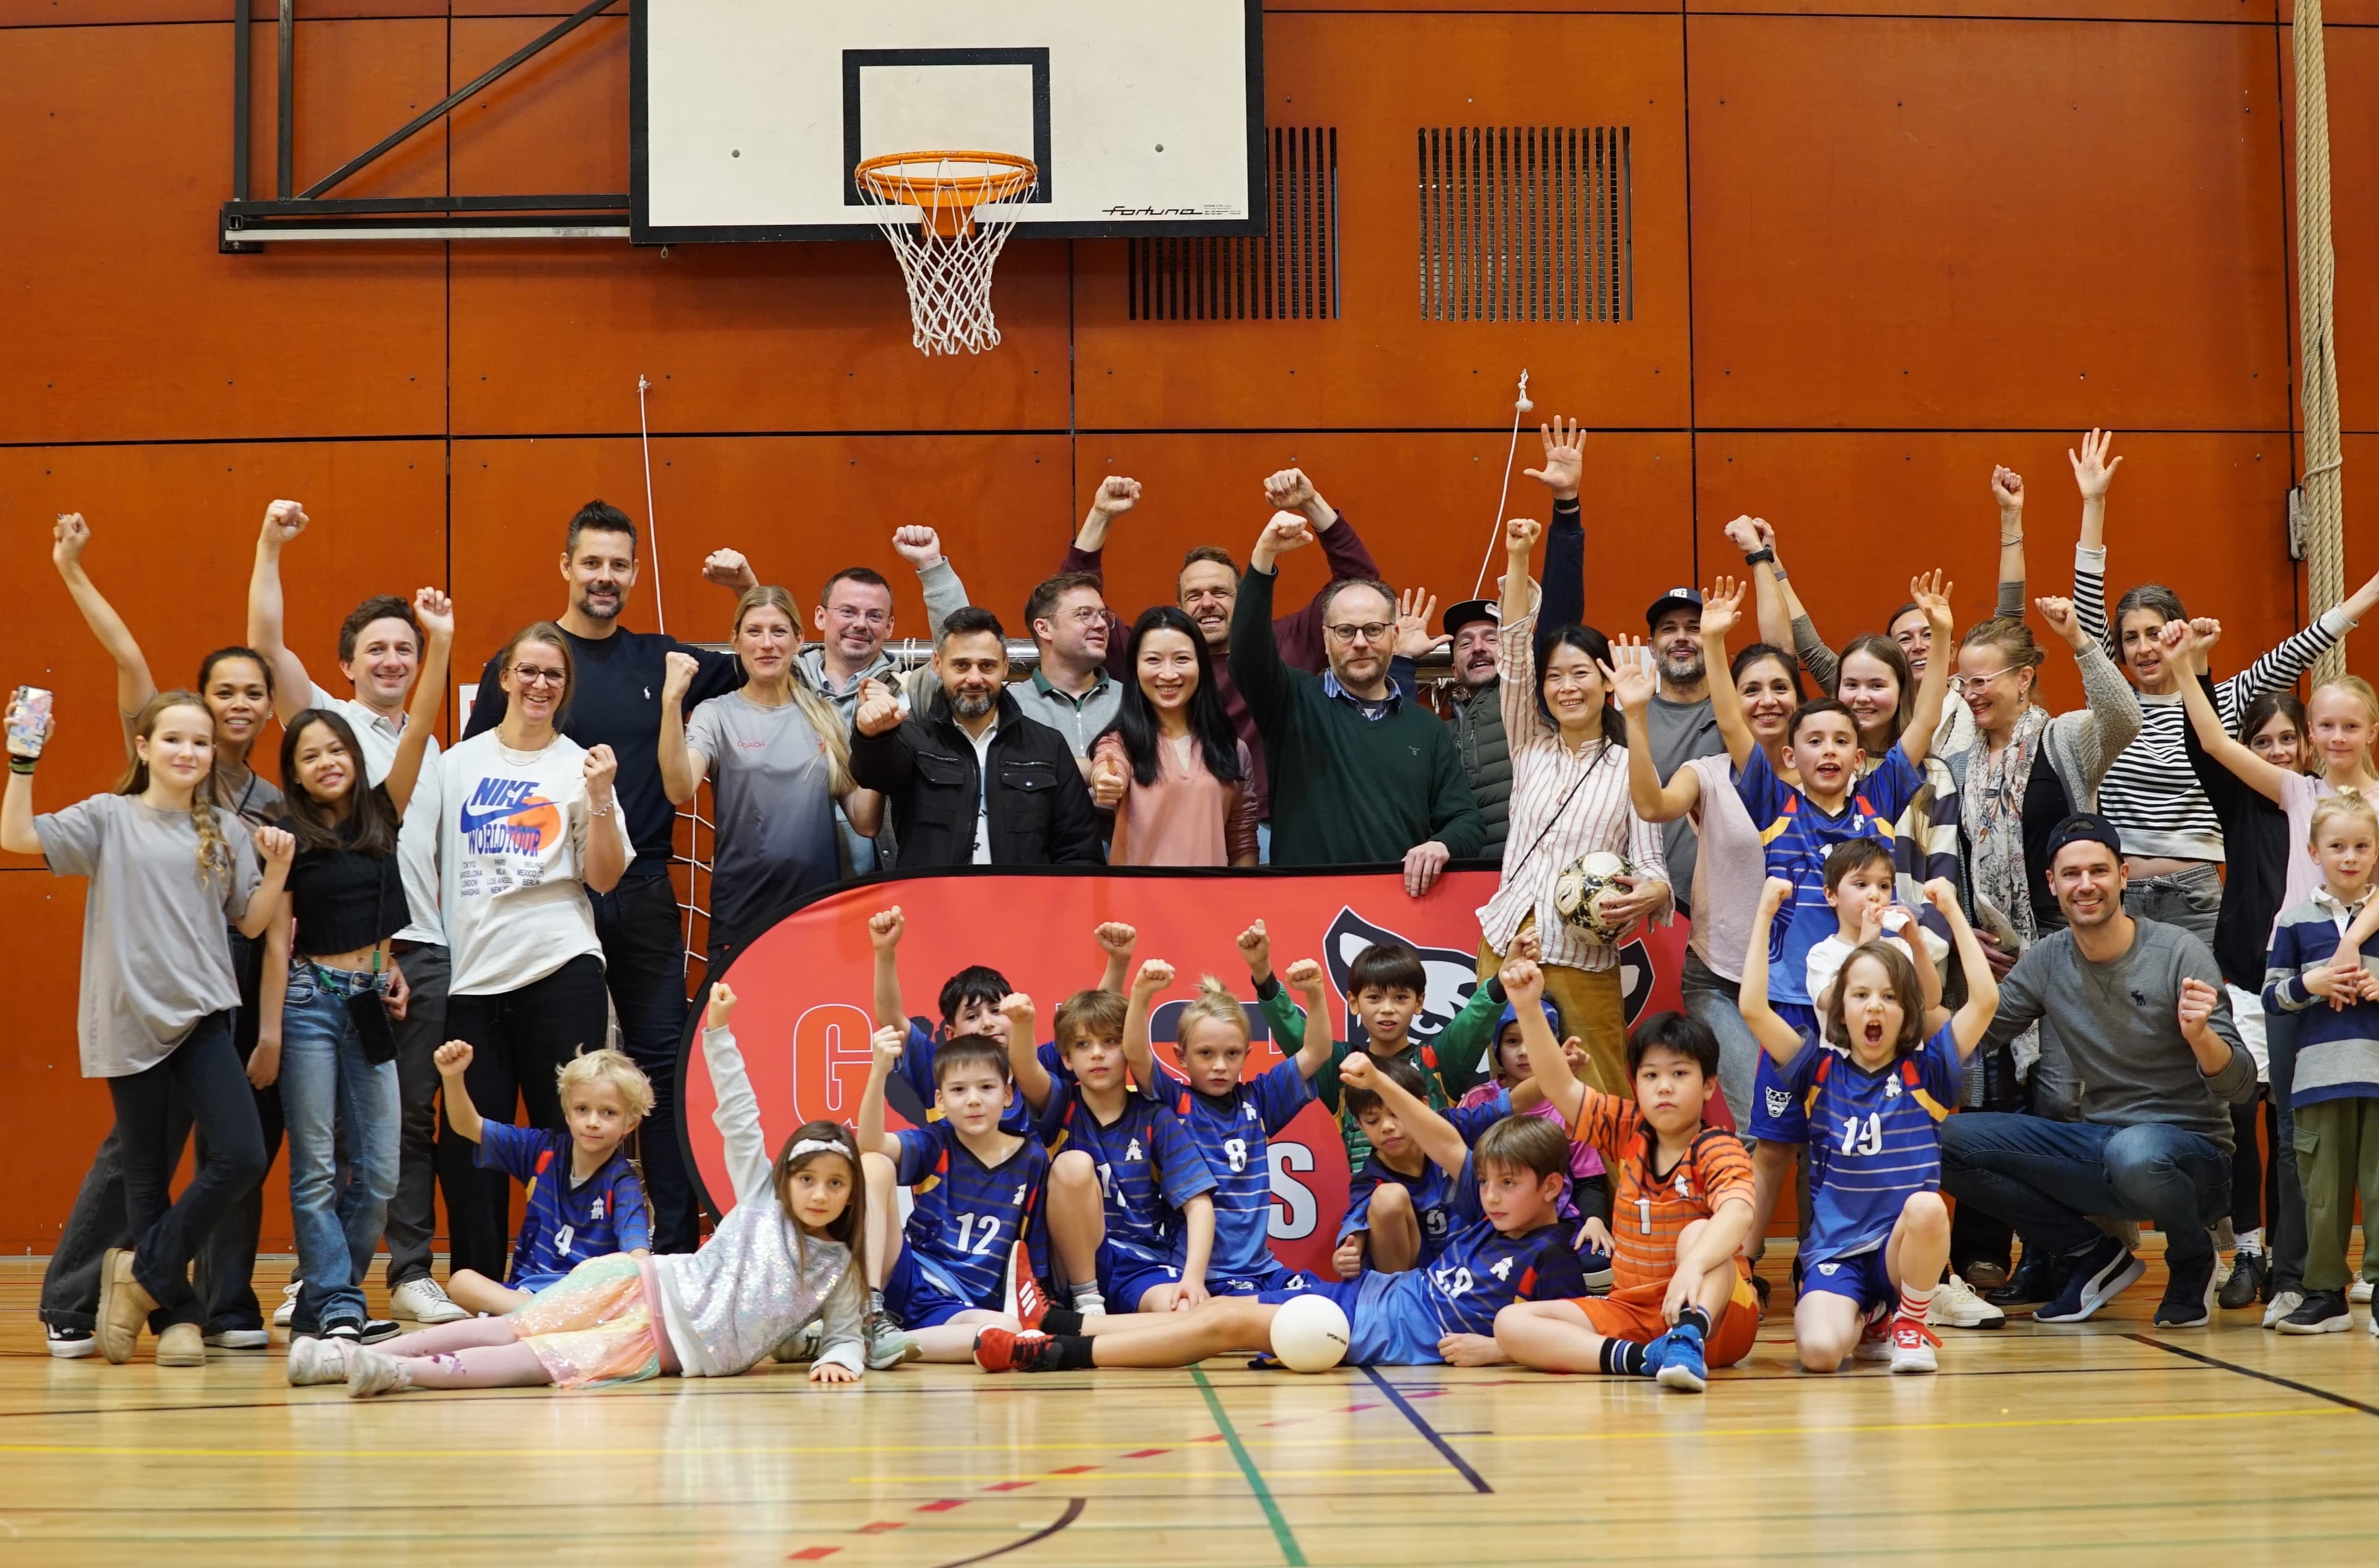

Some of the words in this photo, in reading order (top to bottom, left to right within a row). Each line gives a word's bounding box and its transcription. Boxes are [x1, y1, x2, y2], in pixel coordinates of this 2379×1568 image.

[737, 740, 765, 748] COACH
[470, 777, 540, 808] NIKE
[468, 824, 506, 856] WORLD
[505, 825, 541, 857] TOUR
[1841, 1111, 1883, 1157] 19
[1224, 1138, 1248, 1173] 8
[1633, 1198, 1652, 1235] 1
[553, 1224, 572, 1258] 4
[955, 1212, 1001, 1256] 12
